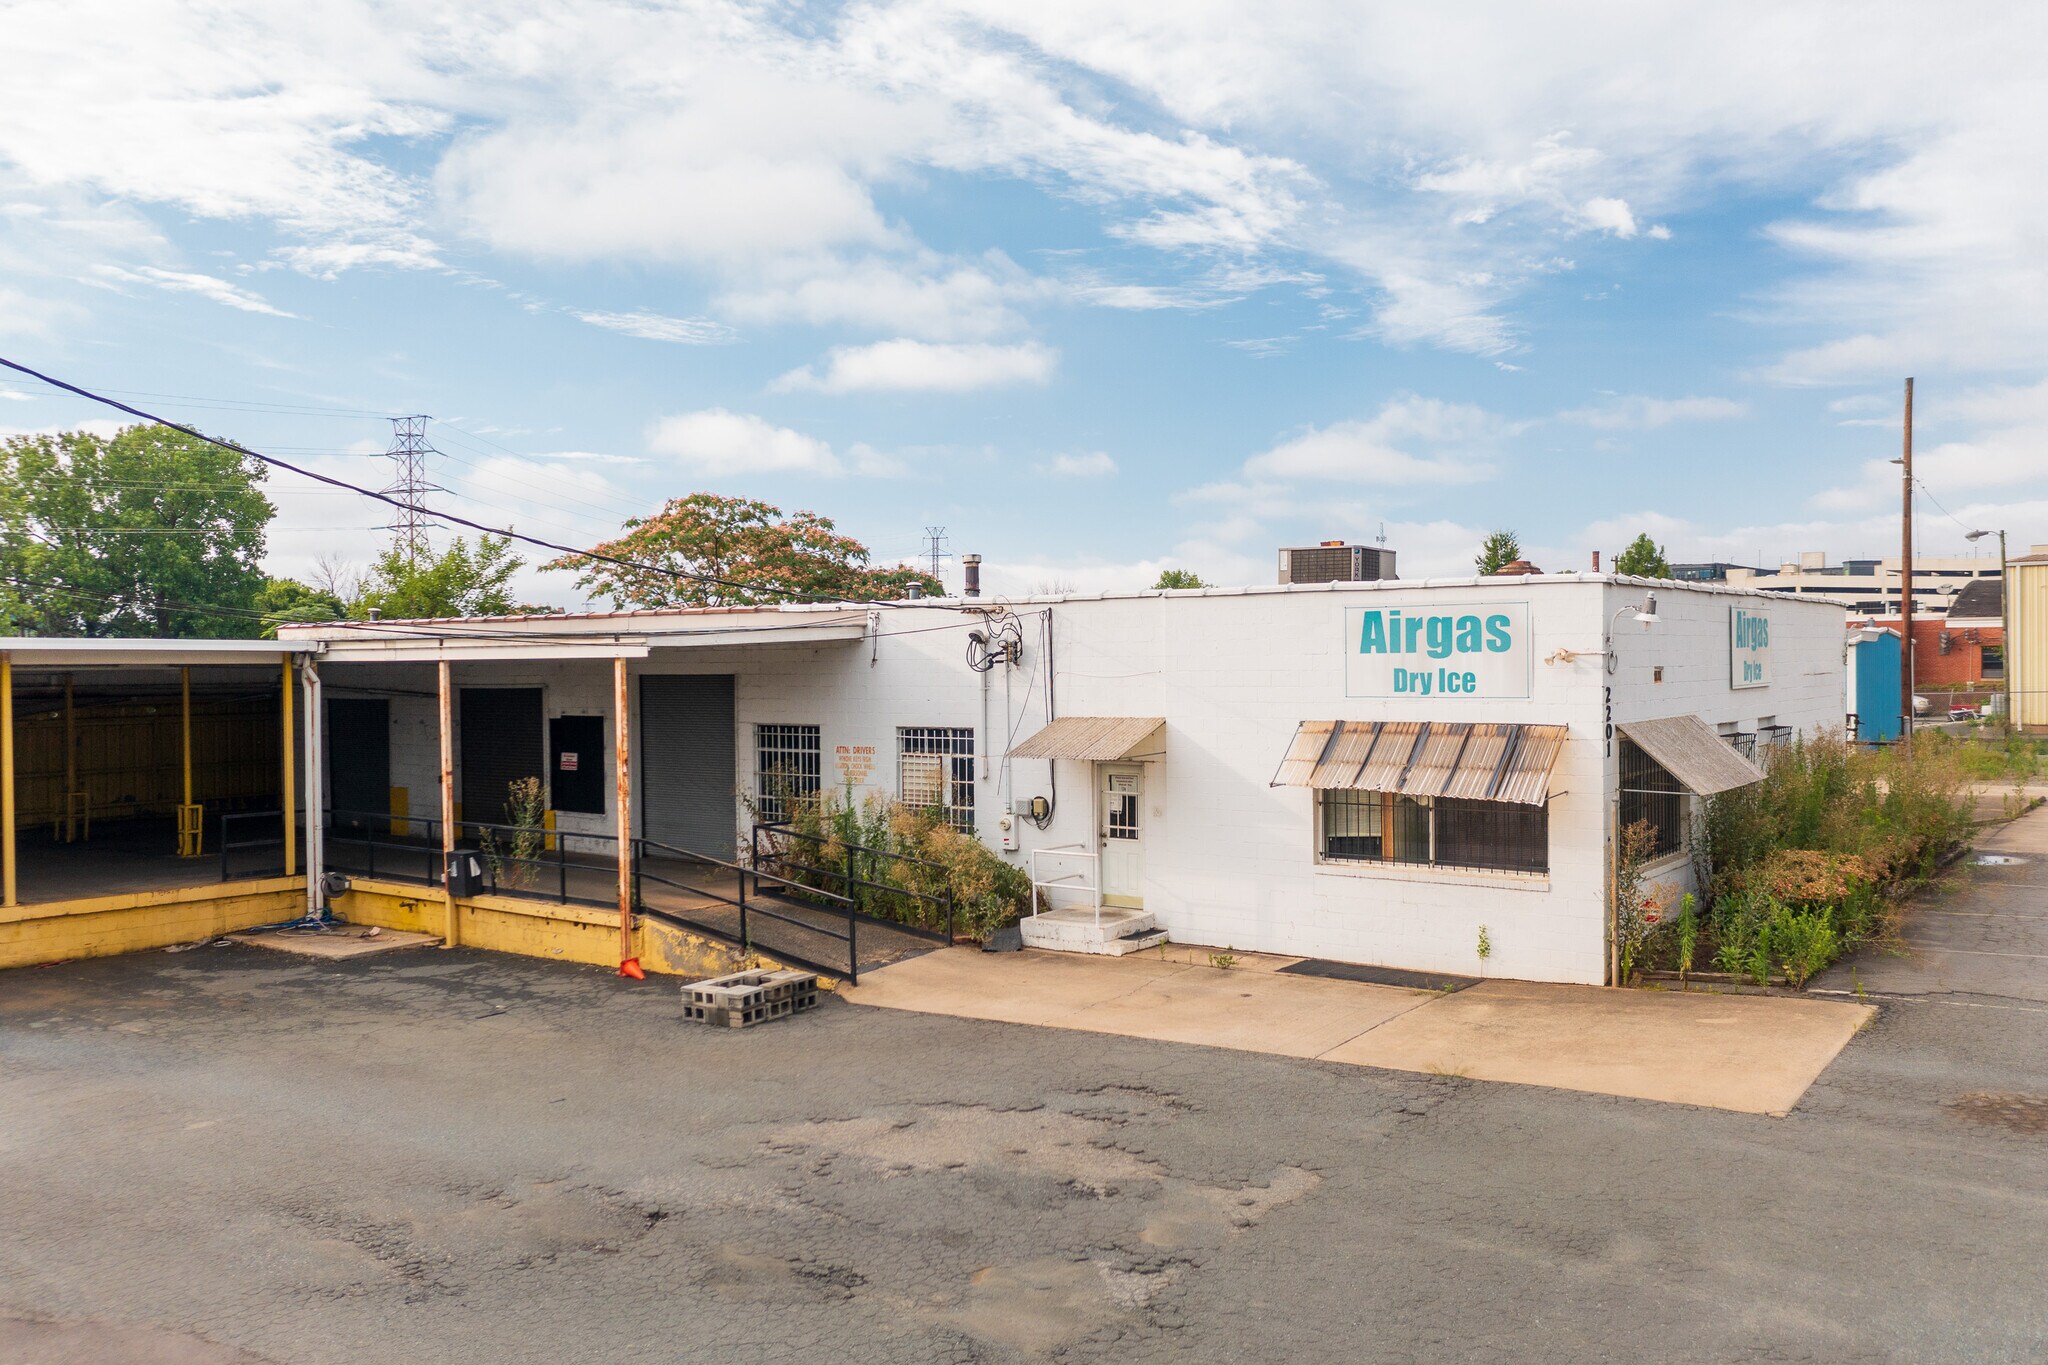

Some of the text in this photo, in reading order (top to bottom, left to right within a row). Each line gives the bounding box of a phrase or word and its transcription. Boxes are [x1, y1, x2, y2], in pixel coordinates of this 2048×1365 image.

[1360, 610, 1512, 659] Airgas
[1736, 610, 1769, 651] Airgas
[1393, 667, 1476, 695] Dry Ice
[1744, 660, 1762, 683] Dry Ice
[1605, 686, 1613, 758] 2201
[836, 745, 875, 754] ATTN: DRIVERS
